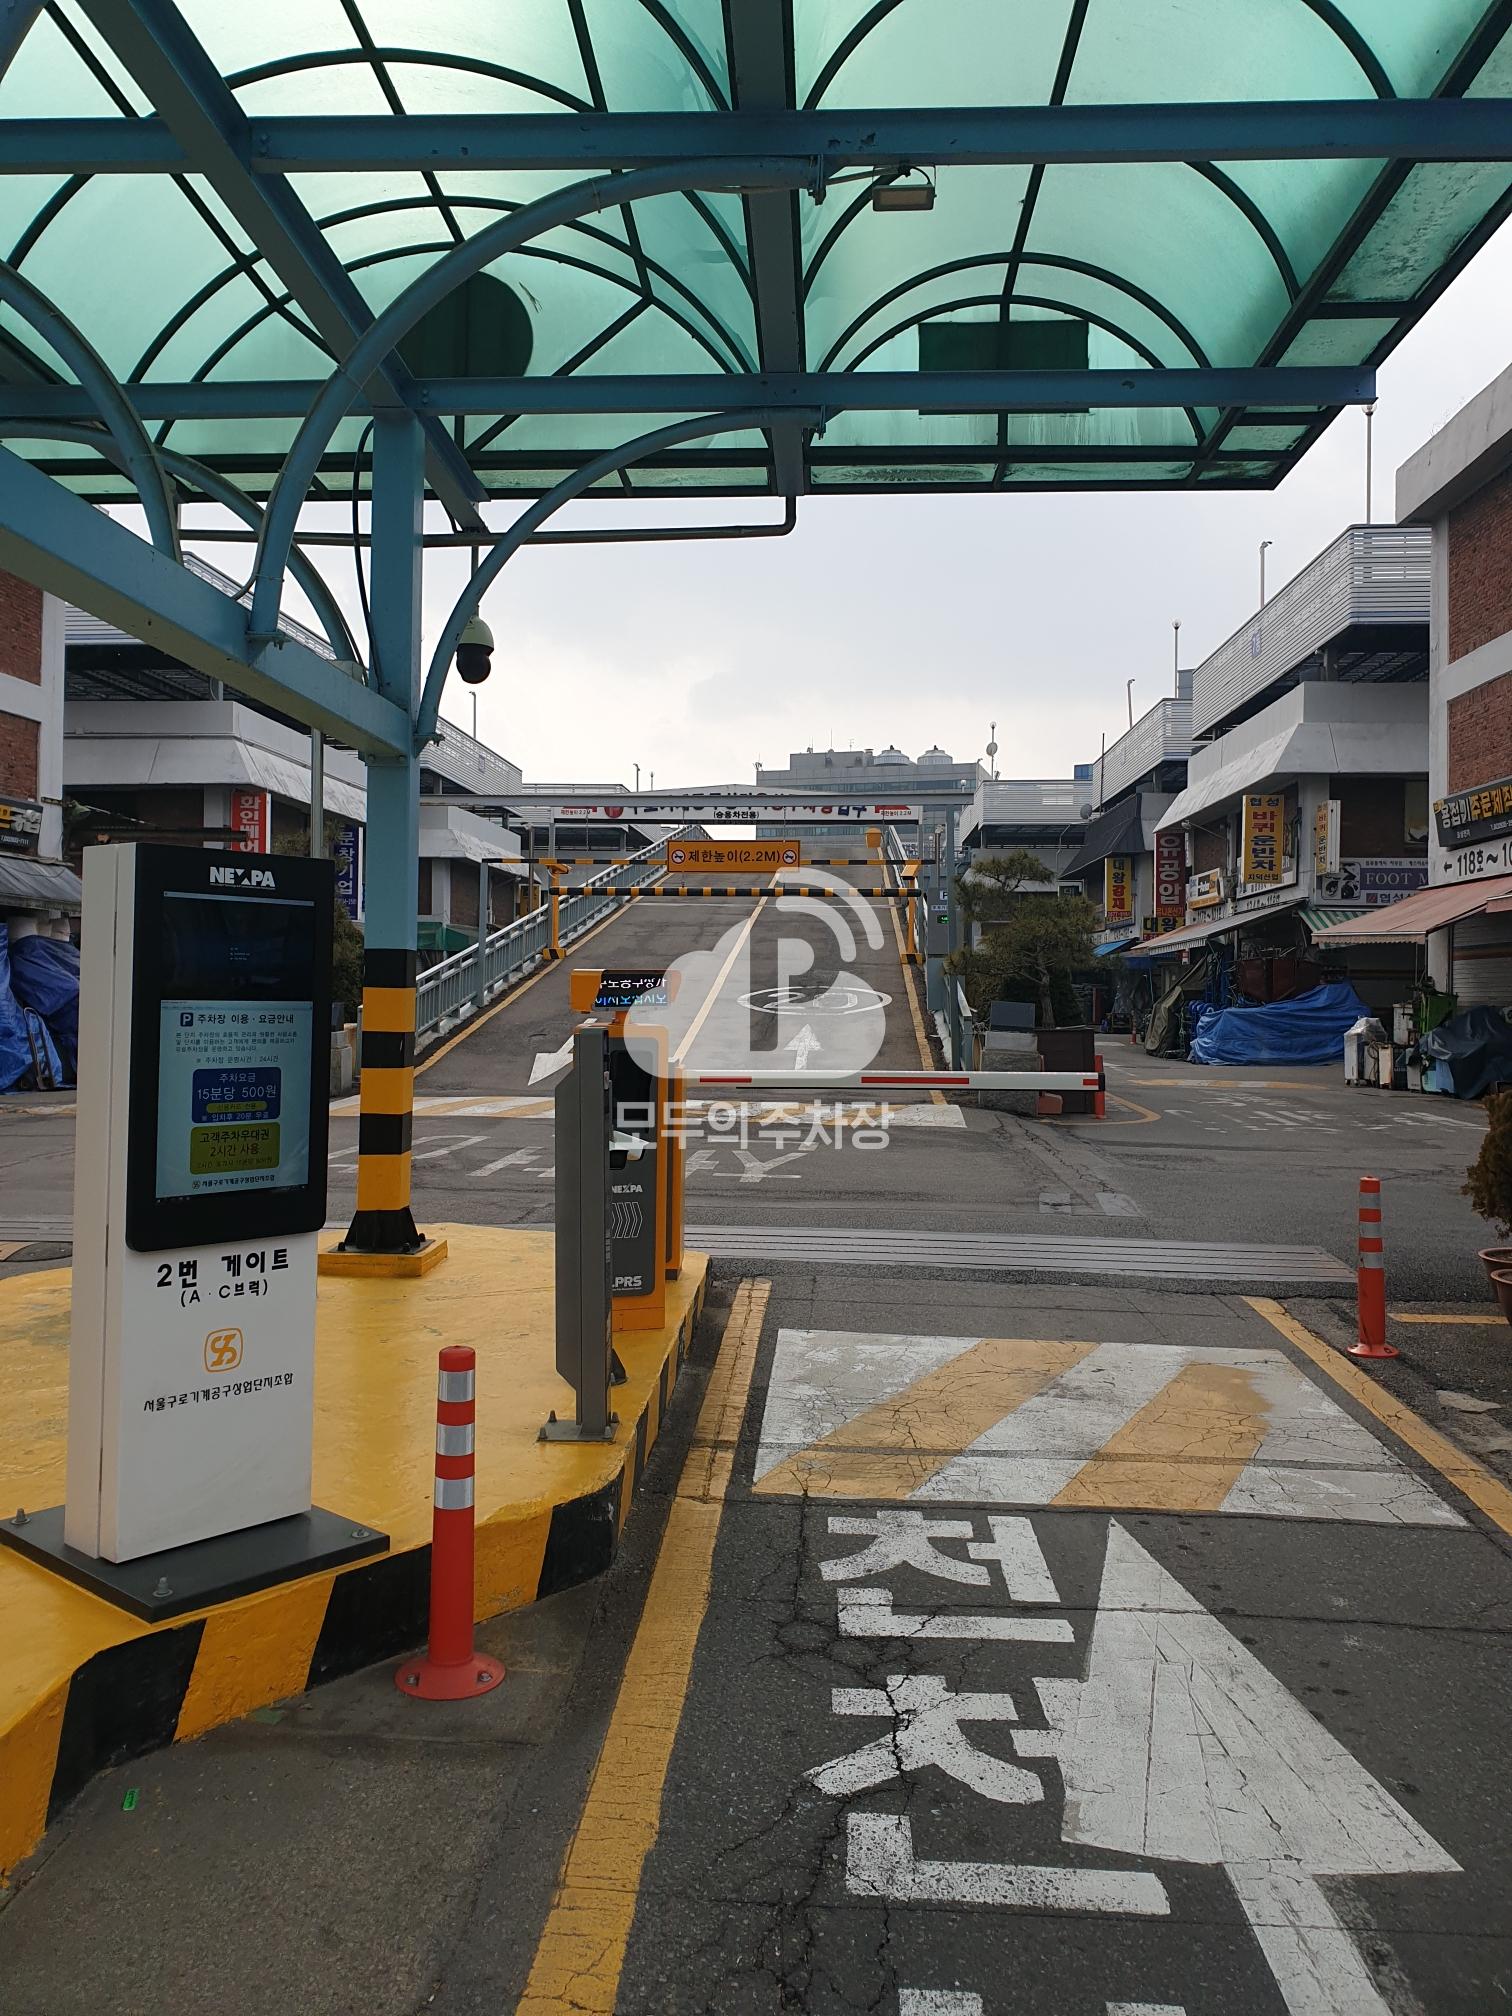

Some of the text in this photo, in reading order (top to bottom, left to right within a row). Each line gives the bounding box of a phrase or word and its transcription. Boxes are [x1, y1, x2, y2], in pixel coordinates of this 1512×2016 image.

[688, 849, 780, 863] 제한높이(2.2M)
[209, 866, 275, 887] NEXPA
[1366, 872, 1412, 884] FOOT
[198, 1014, 226, 1024] 주차장
[231, 1014, 249, 1024] 이용
[258, 1014, 294, 1024] 요금안내
[219, 1072, 256, 1083] 주차요금
[197, 1084, 277, 1100] 15분당 500원
[200, 1128, 270, 1143] 고객주차우대권
[210, 1145, 236, 1157] 2시간
[157, 1248, 289, 1289] 2번 게이트
[143, 1372, 294, 1412] 서울구로기계공구상업단지조합
